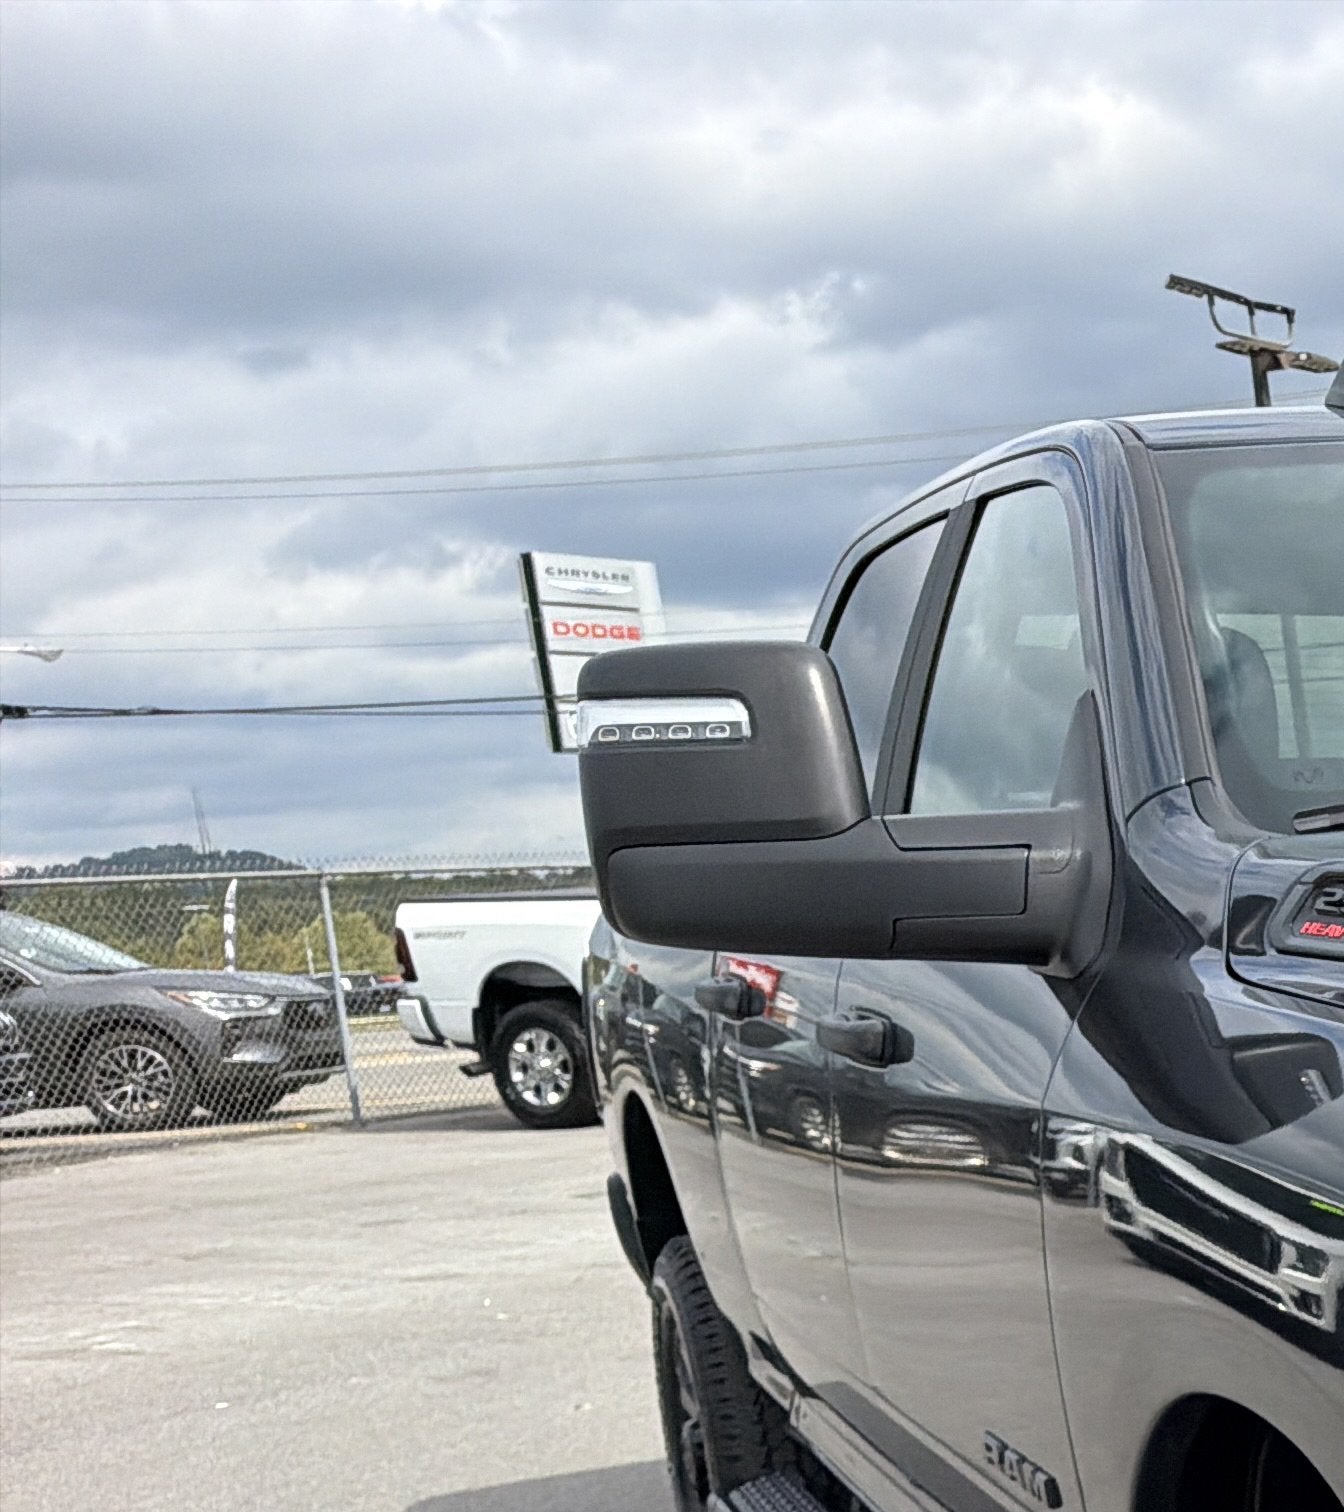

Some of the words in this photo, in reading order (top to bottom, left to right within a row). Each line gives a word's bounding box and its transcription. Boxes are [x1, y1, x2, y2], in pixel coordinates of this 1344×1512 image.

[545, 566, 630, 581] CHRYSLER
[552, 621, 641, 640] DODGE
[983, 1430, 1062, 1509] RAM
